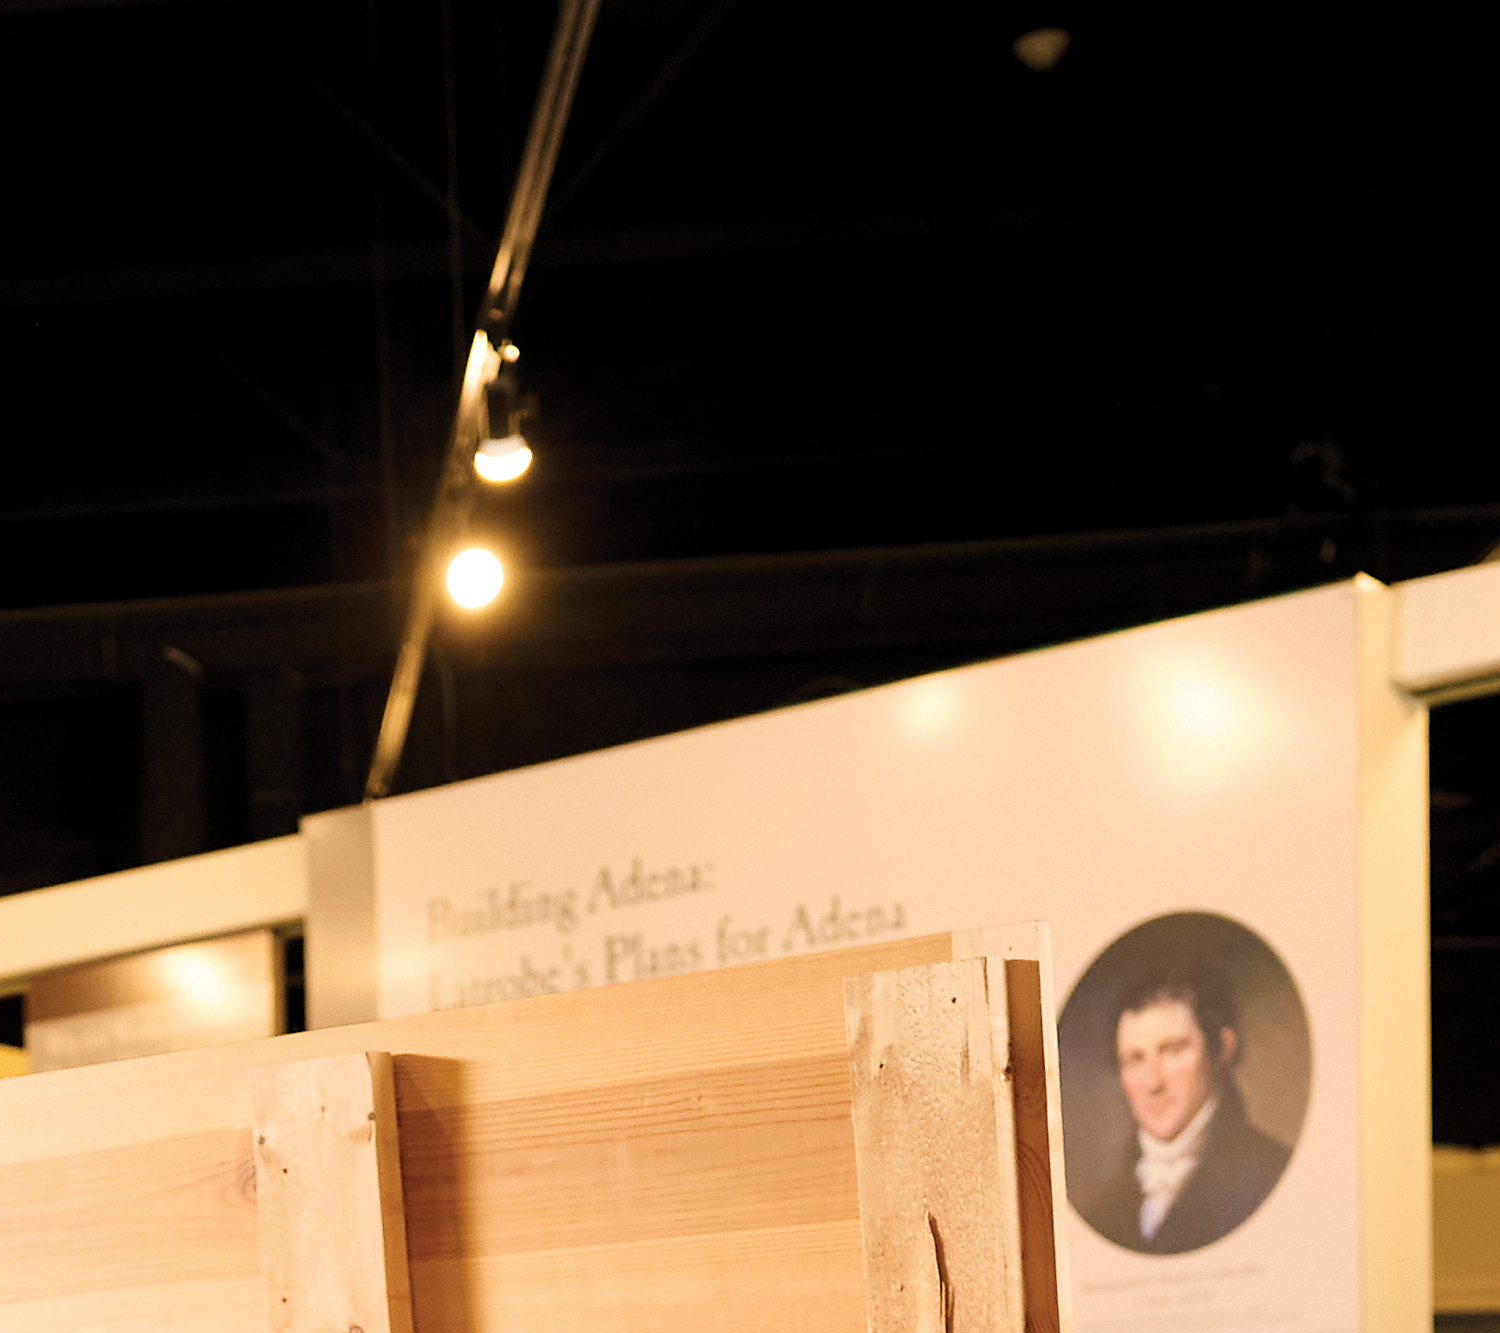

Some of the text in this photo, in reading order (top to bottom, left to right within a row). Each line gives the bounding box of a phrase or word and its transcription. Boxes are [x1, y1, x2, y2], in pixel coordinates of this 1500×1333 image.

[426, 855, 716, 943] Building Adena:
[606, 932, 701, 984] Plans
[717, 914, 771, 965] for
[782, 896, 907, 950] Adena
